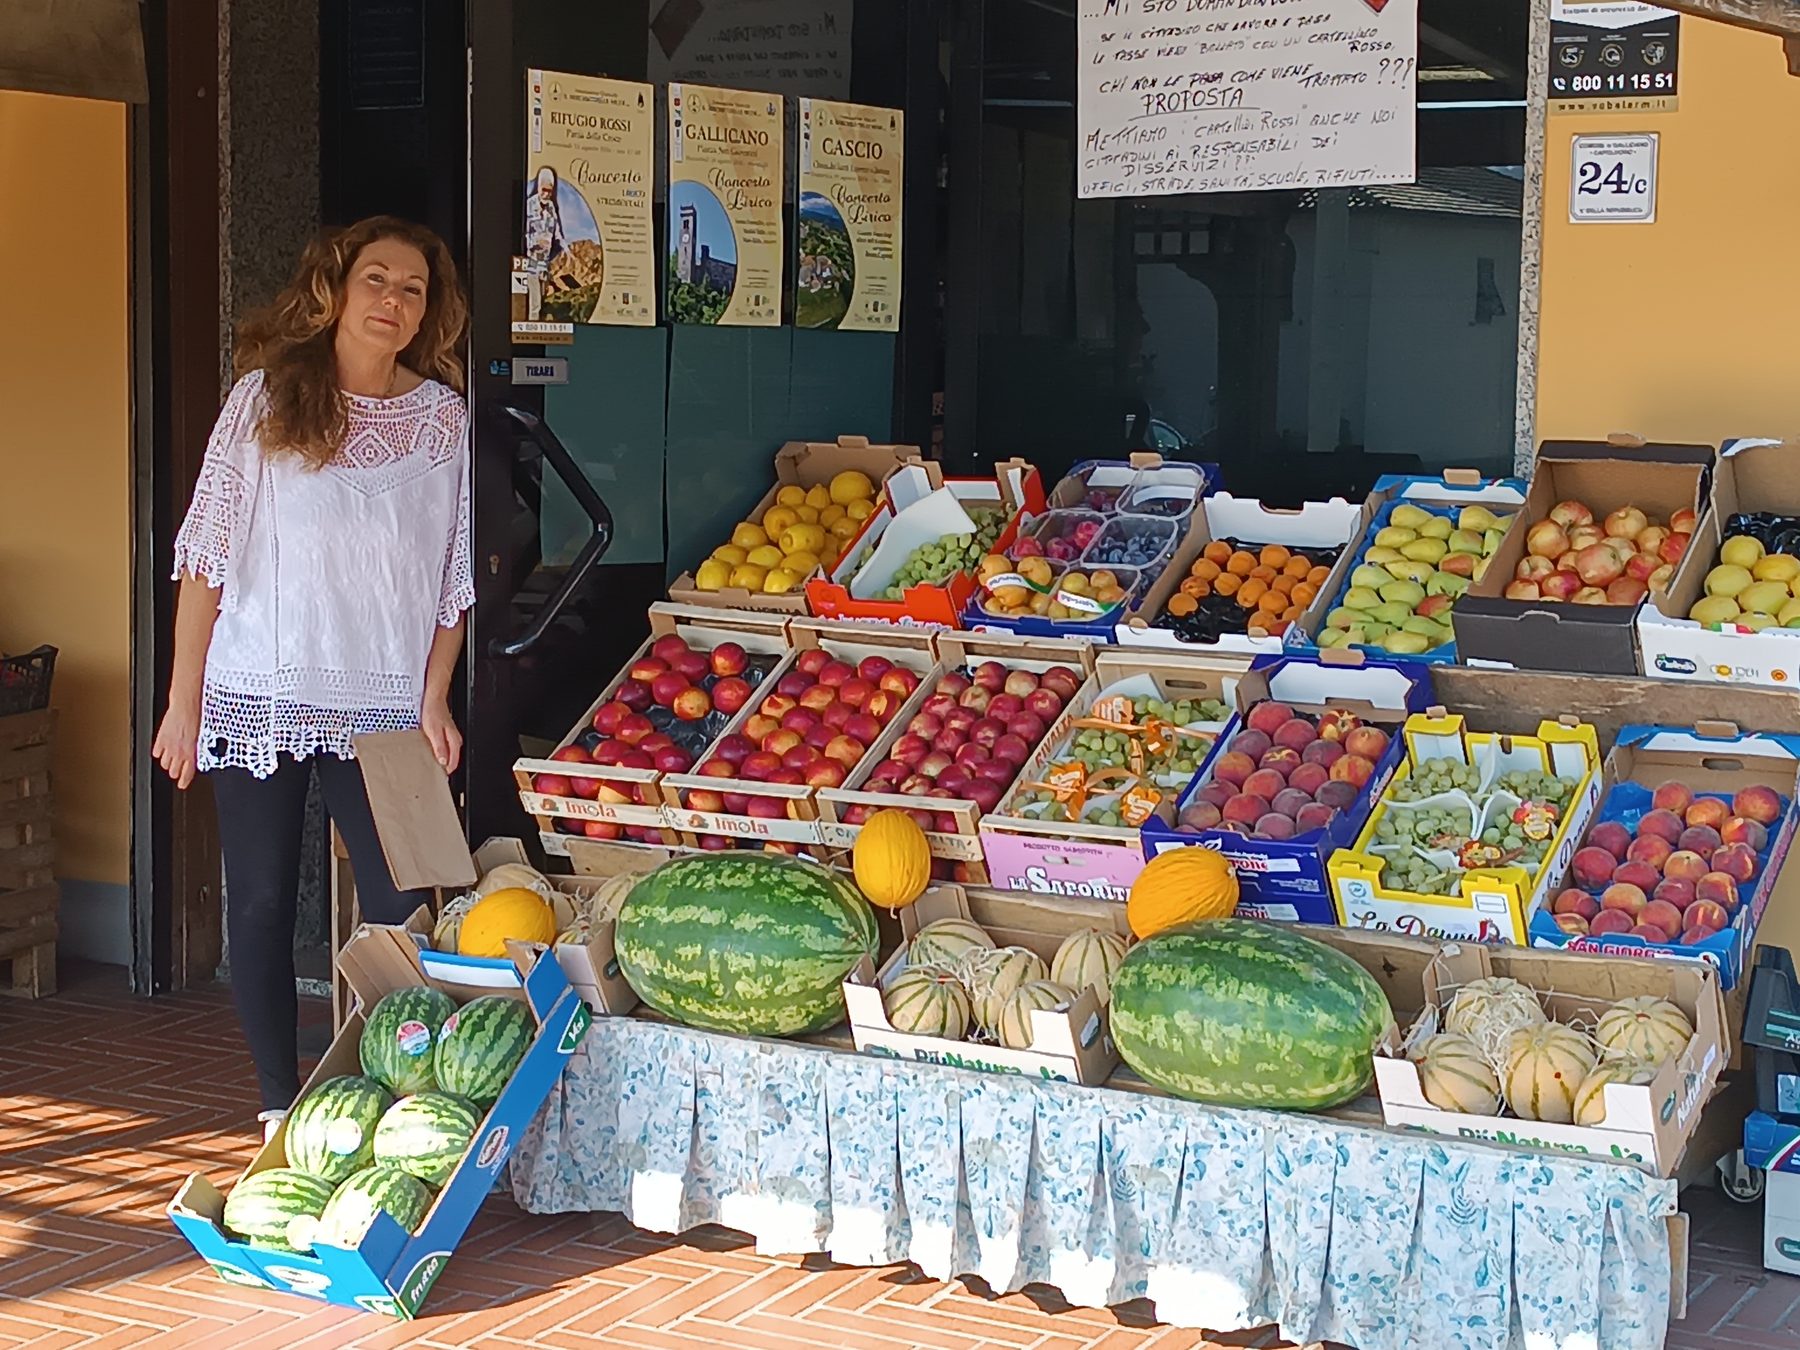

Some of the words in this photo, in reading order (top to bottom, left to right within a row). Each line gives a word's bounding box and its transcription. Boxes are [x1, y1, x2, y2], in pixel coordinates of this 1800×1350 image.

[1099, 76, 1128, 93] CHI
[1572, 75, 1602, 91] 800
[1607, 74, 1625, 89] 11
[1631, 73, 1651, 89] 15
[1655, 73, 1673, 88] 51
[1140, 87, 1243, 115] PROPOSTA
[551, 111, 597, 128] RIFUGIO
[600, 117, 631, 132] ROSSI
[685, 124, 769, 146] GALLICANO
[823, 137, 883, 160] CASCIO
[570, 158, 642, 189] Concerto
[708, 167, 771, 192] Concerto
[727, 188, 772, 210] Lirico
[831, 183, 891, 207] Concerto
[848, 205, 891, 225] Lirico
[565, 800, 617, 819] Imola
[714, 816, 769, 835] Imola
[1026, 865, 1132, 902] SAPORIT
[1567, 941, 1598, 953] SAN
